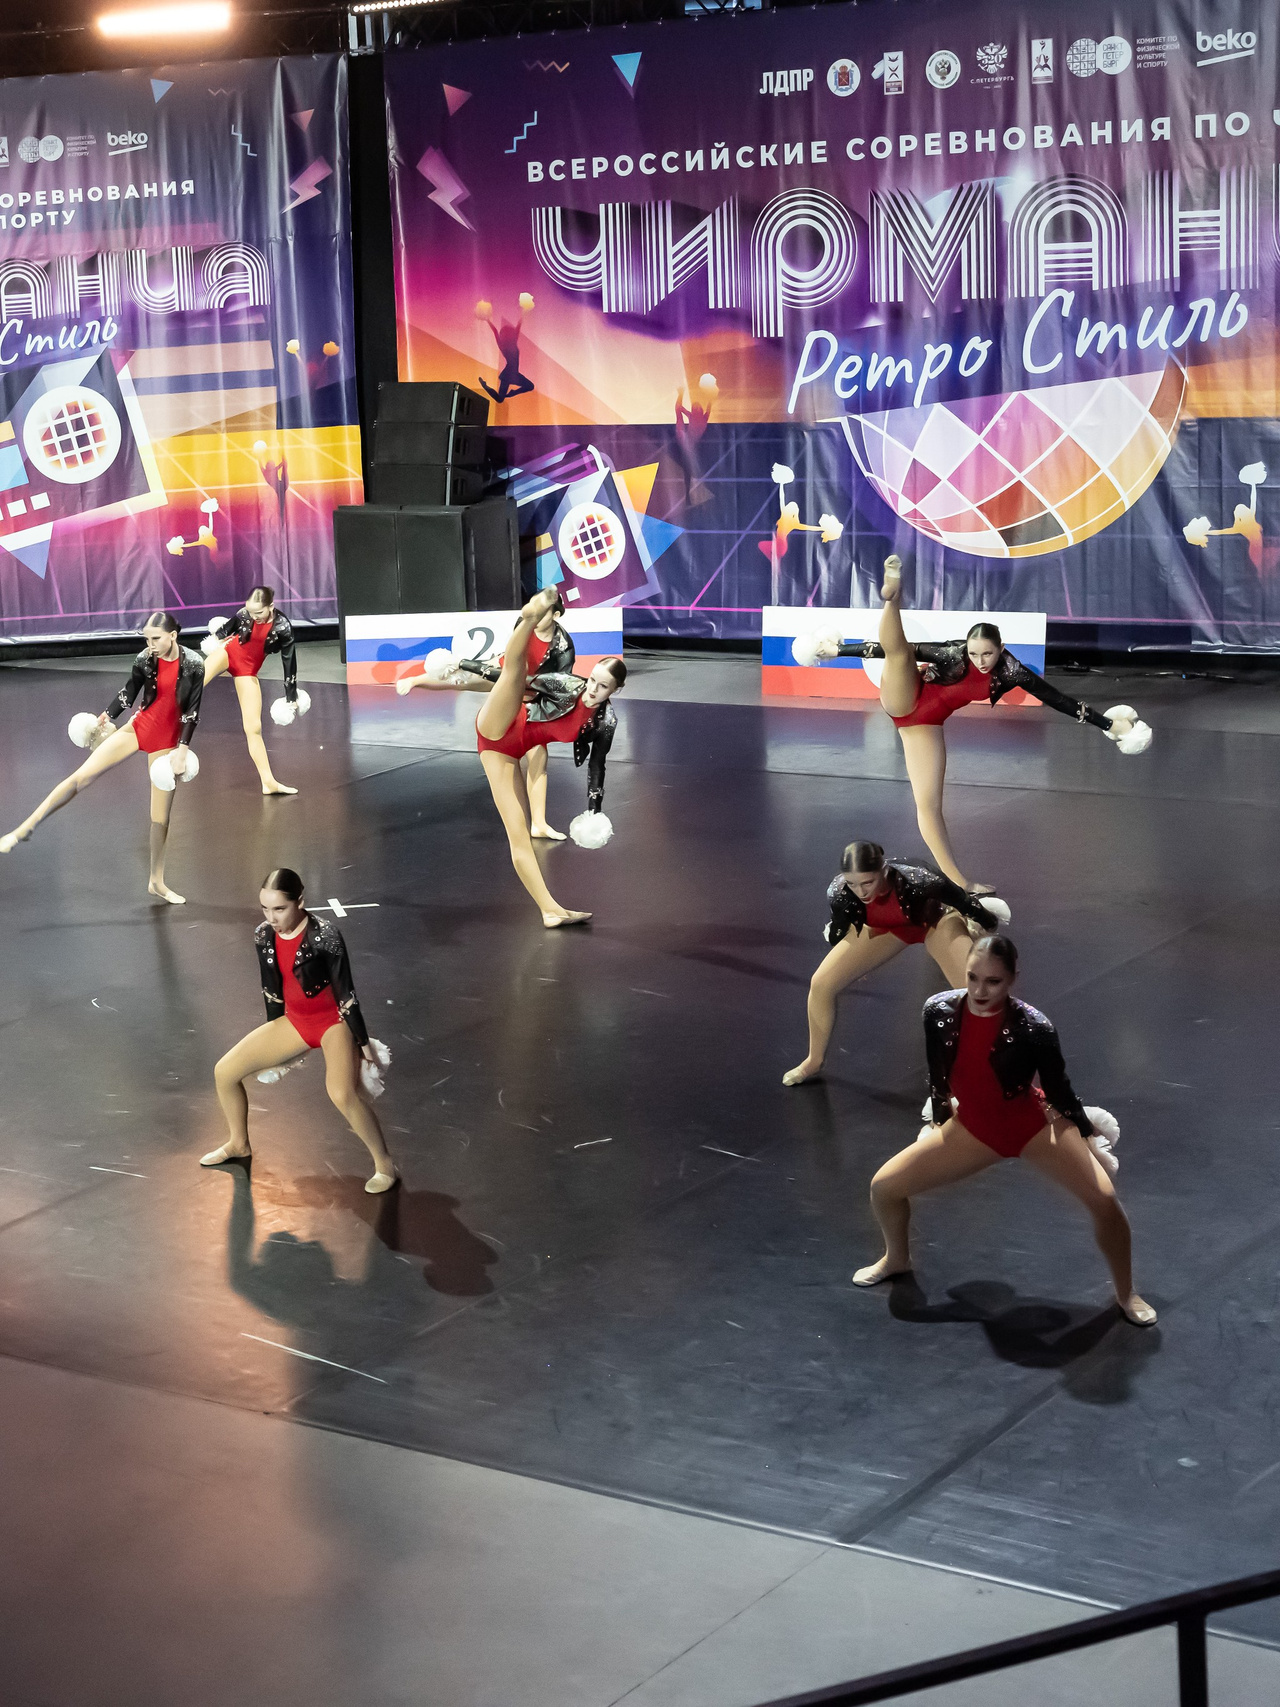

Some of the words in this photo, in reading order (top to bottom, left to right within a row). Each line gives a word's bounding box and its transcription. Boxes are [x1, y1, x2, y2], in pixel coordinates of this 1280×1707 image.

[1136, 36, 1167, 45] КОМИТЕТ
[1167, 35, 1178, 43] ПО
[1136, 42, 1180, 53] ФИЗИЧЕСКОЙ
[1196, 28, 1257, 53] beko
[1136, 52, 1167, 61] КУЛЬТУРЕ
[1143, 60, 1169, 69] СПОРТУ
[759, 68, 814, 97] ЛДПР
[106, 130, 149, 147] beko
[527, 140, 828, 183] ВСЕРОССИЙСКИЕ
[845, 116, 1171, 162] СОРЕВНОВАНИЯ
[1195, 111, 1251, 139] ПО
[531, 162, 1280, 338] ЧИРМАН
[787, 329, 993, 415] Ретро
[1021, 288, 1249, 374] Стиль
[467, 626, 496, 661] 2
